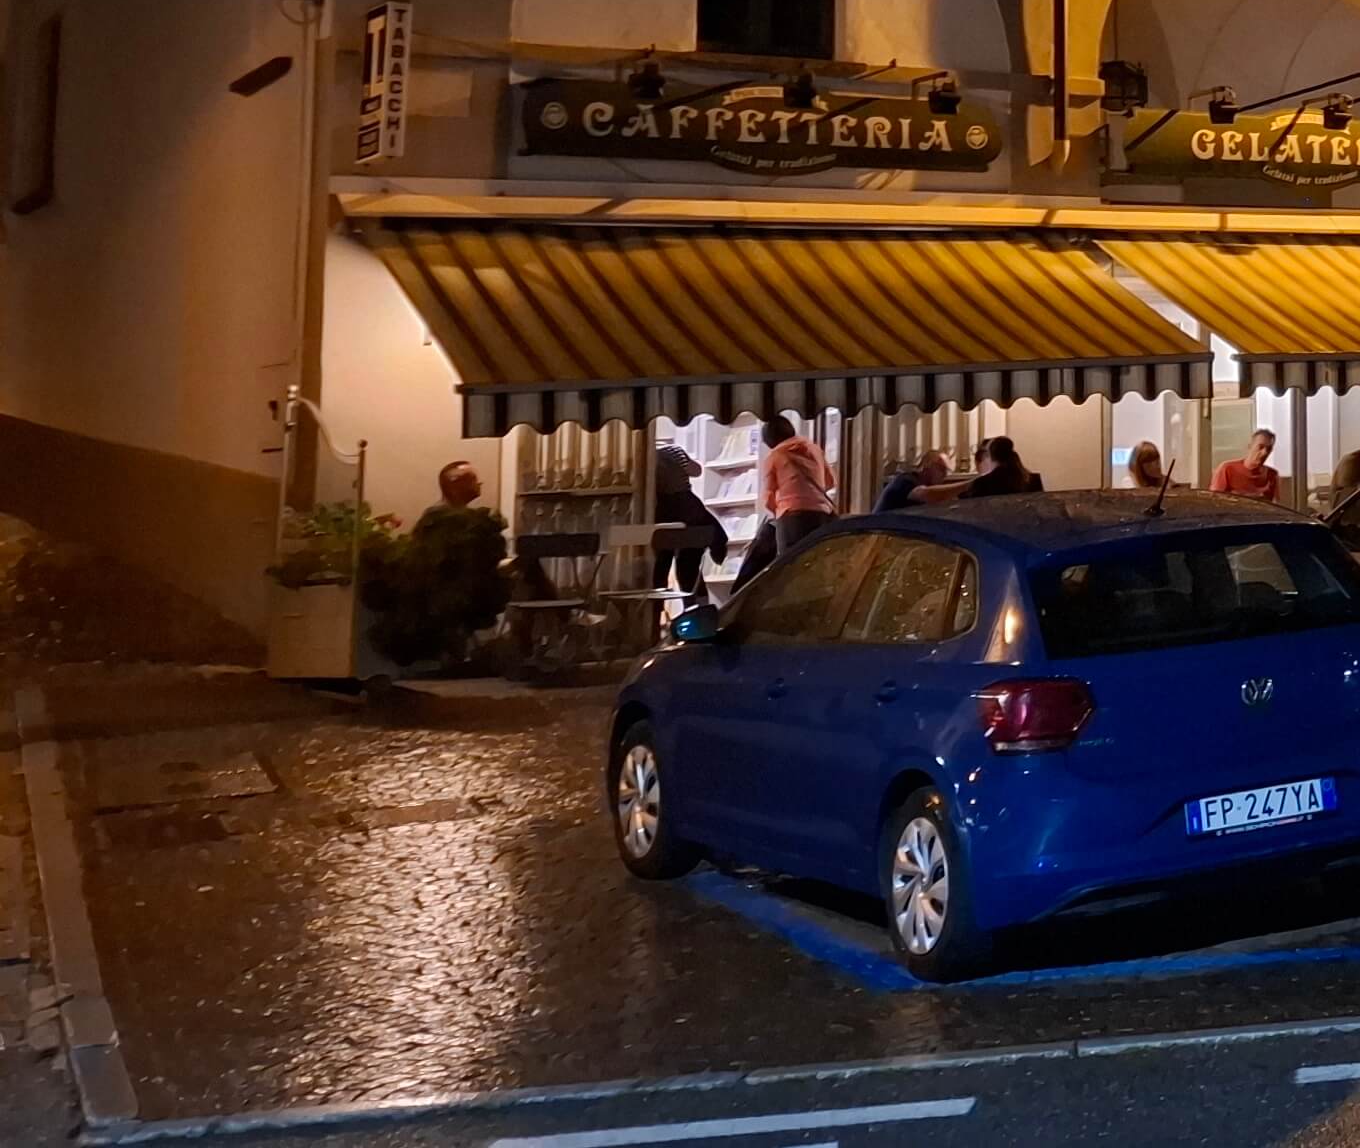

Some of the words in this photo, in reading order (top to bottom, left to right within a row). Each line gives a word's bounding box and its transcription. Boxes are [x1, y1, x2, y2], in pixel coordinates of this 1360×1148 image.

[386, 8, 408, 149] TABACCHI
[582, 101, 953, 152] CAFFETTERIA
[1204, 797, 1234, 828] FP
[1244, 781, 1321, 820] 247YA
